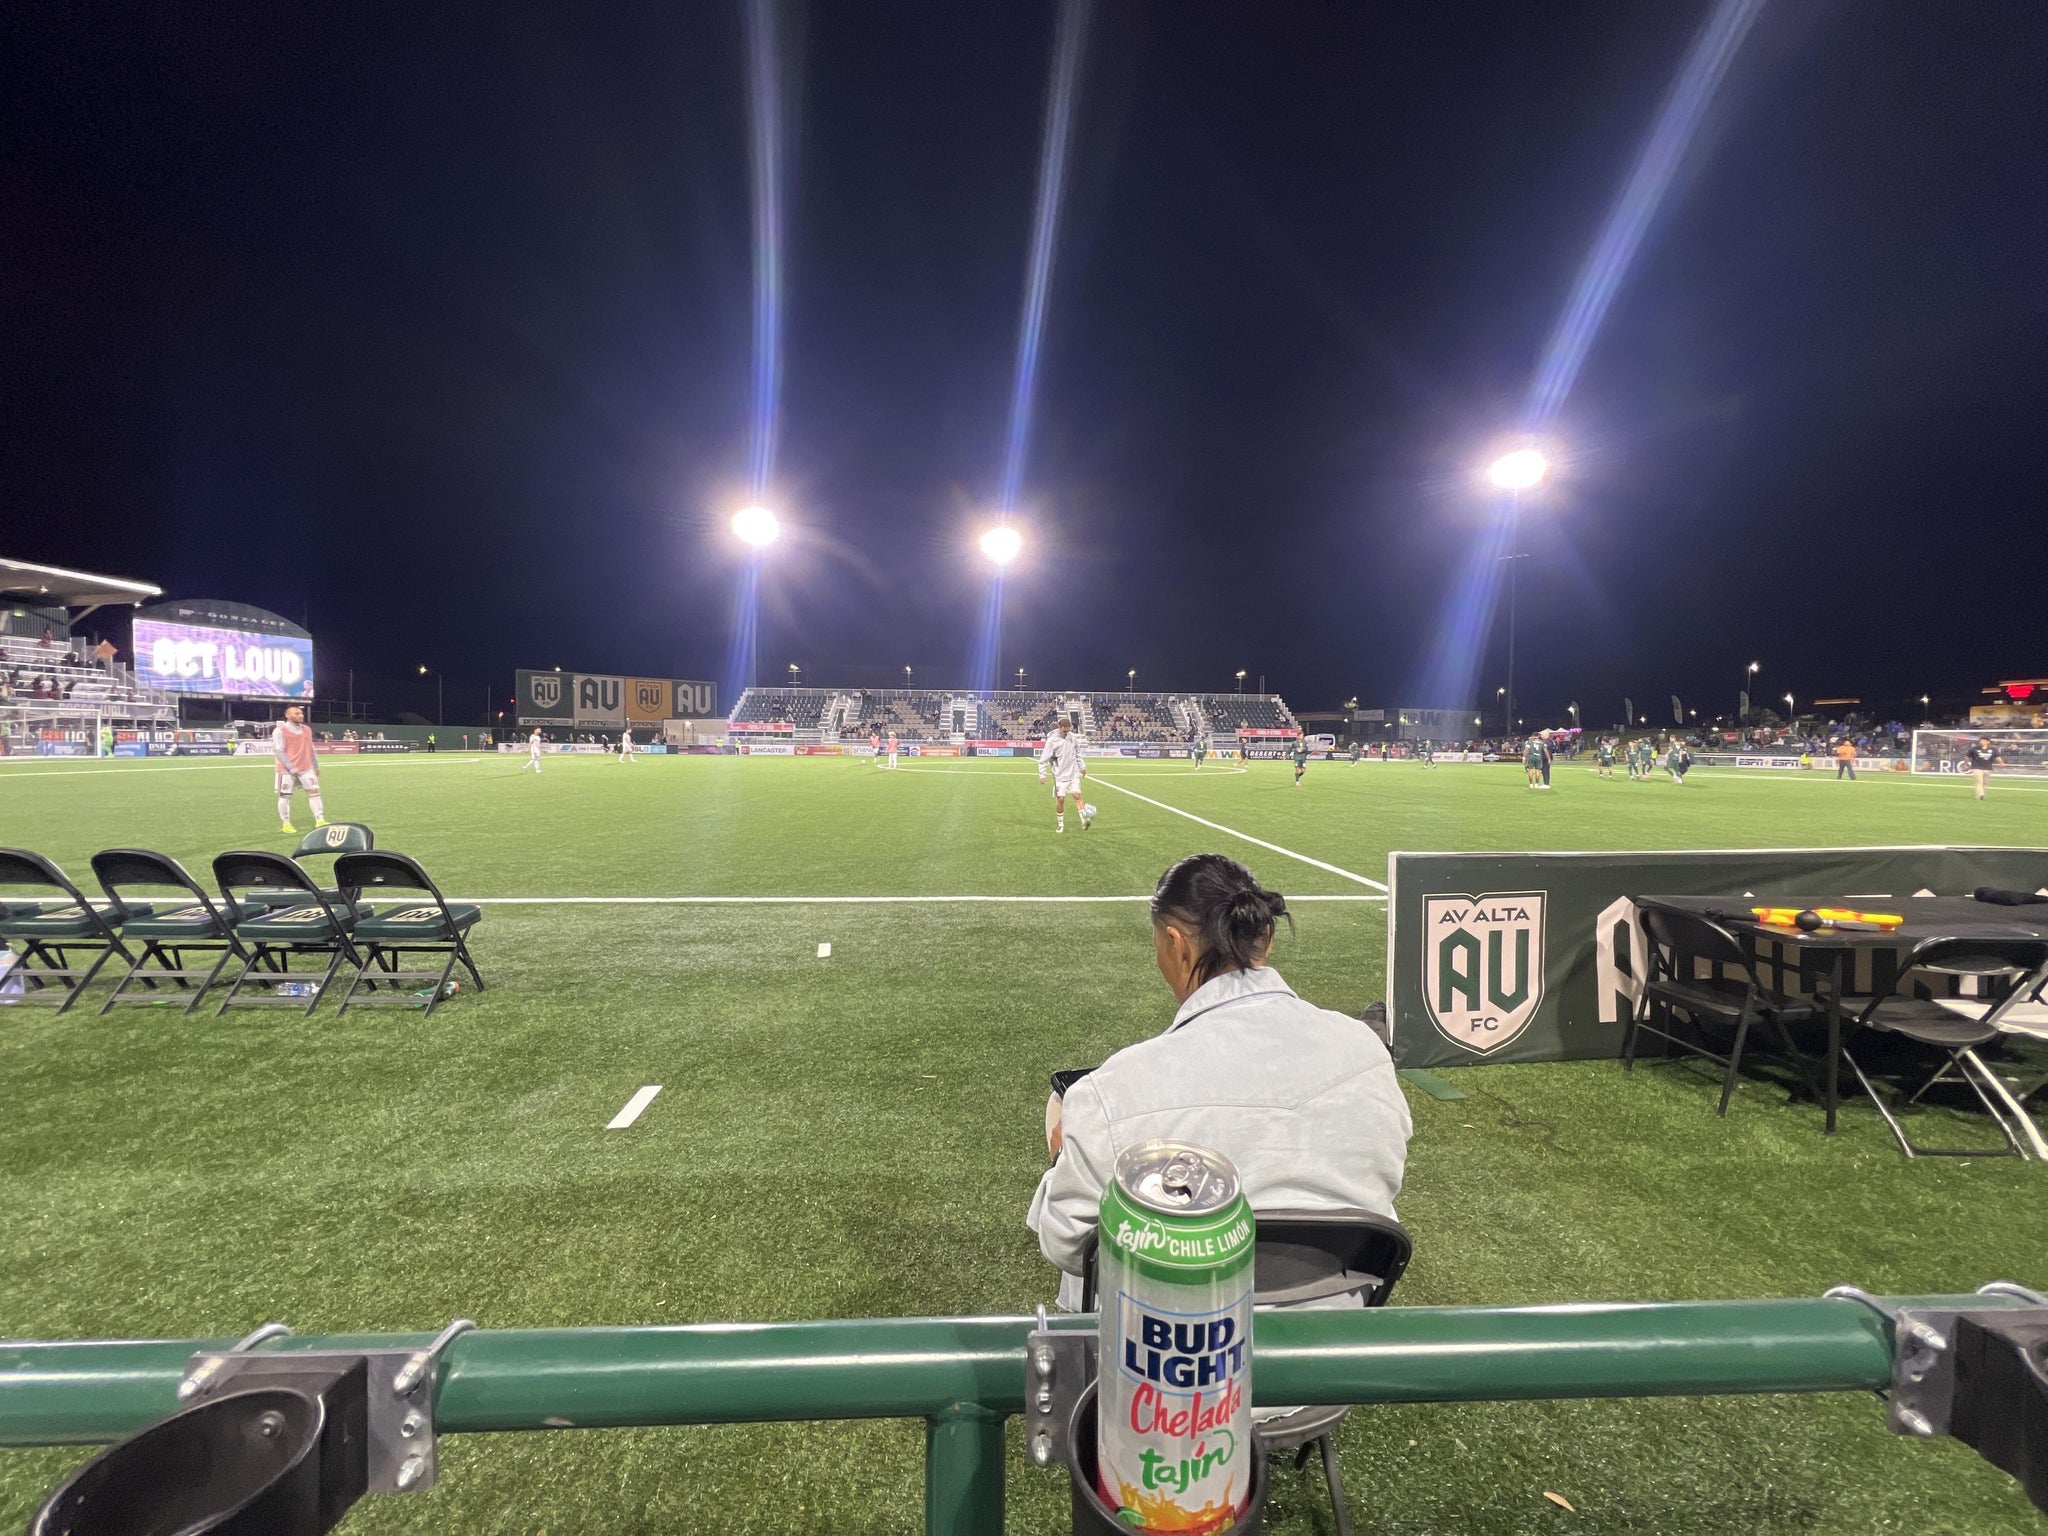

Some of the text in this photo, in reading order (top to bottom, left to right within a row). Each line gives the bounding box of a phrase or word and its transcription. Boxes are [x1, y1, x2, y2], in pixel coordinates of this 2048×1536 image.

[153, 639, 303, 684] GET LOUD
[534, 682, 558, 701] AU
[580, 678, 619, 711] AU
[640, 688, 659, 705] AU
[677, 683, 711, 714] AU
[1738, 758, 1764, 766] ESPN
[1771, 759, 1799, 767] ESPN
[328, 830, 346, 841] AU
[1439, 907, 1530, 924] AV ALTA
[1439, 927, 1530, 1014] AU
[1470, 1016, 1499, 1032] FC
[1169, 1238, 1215, 1257] CHILE
[1218, 1218, 1251, 1253] LIMÓN
[1143, 1314, 1236, 1355] BUD
[1126, 1336, 1246, 1388] LIGHT
[1130, 1377, 1242, 1440] Chelada
